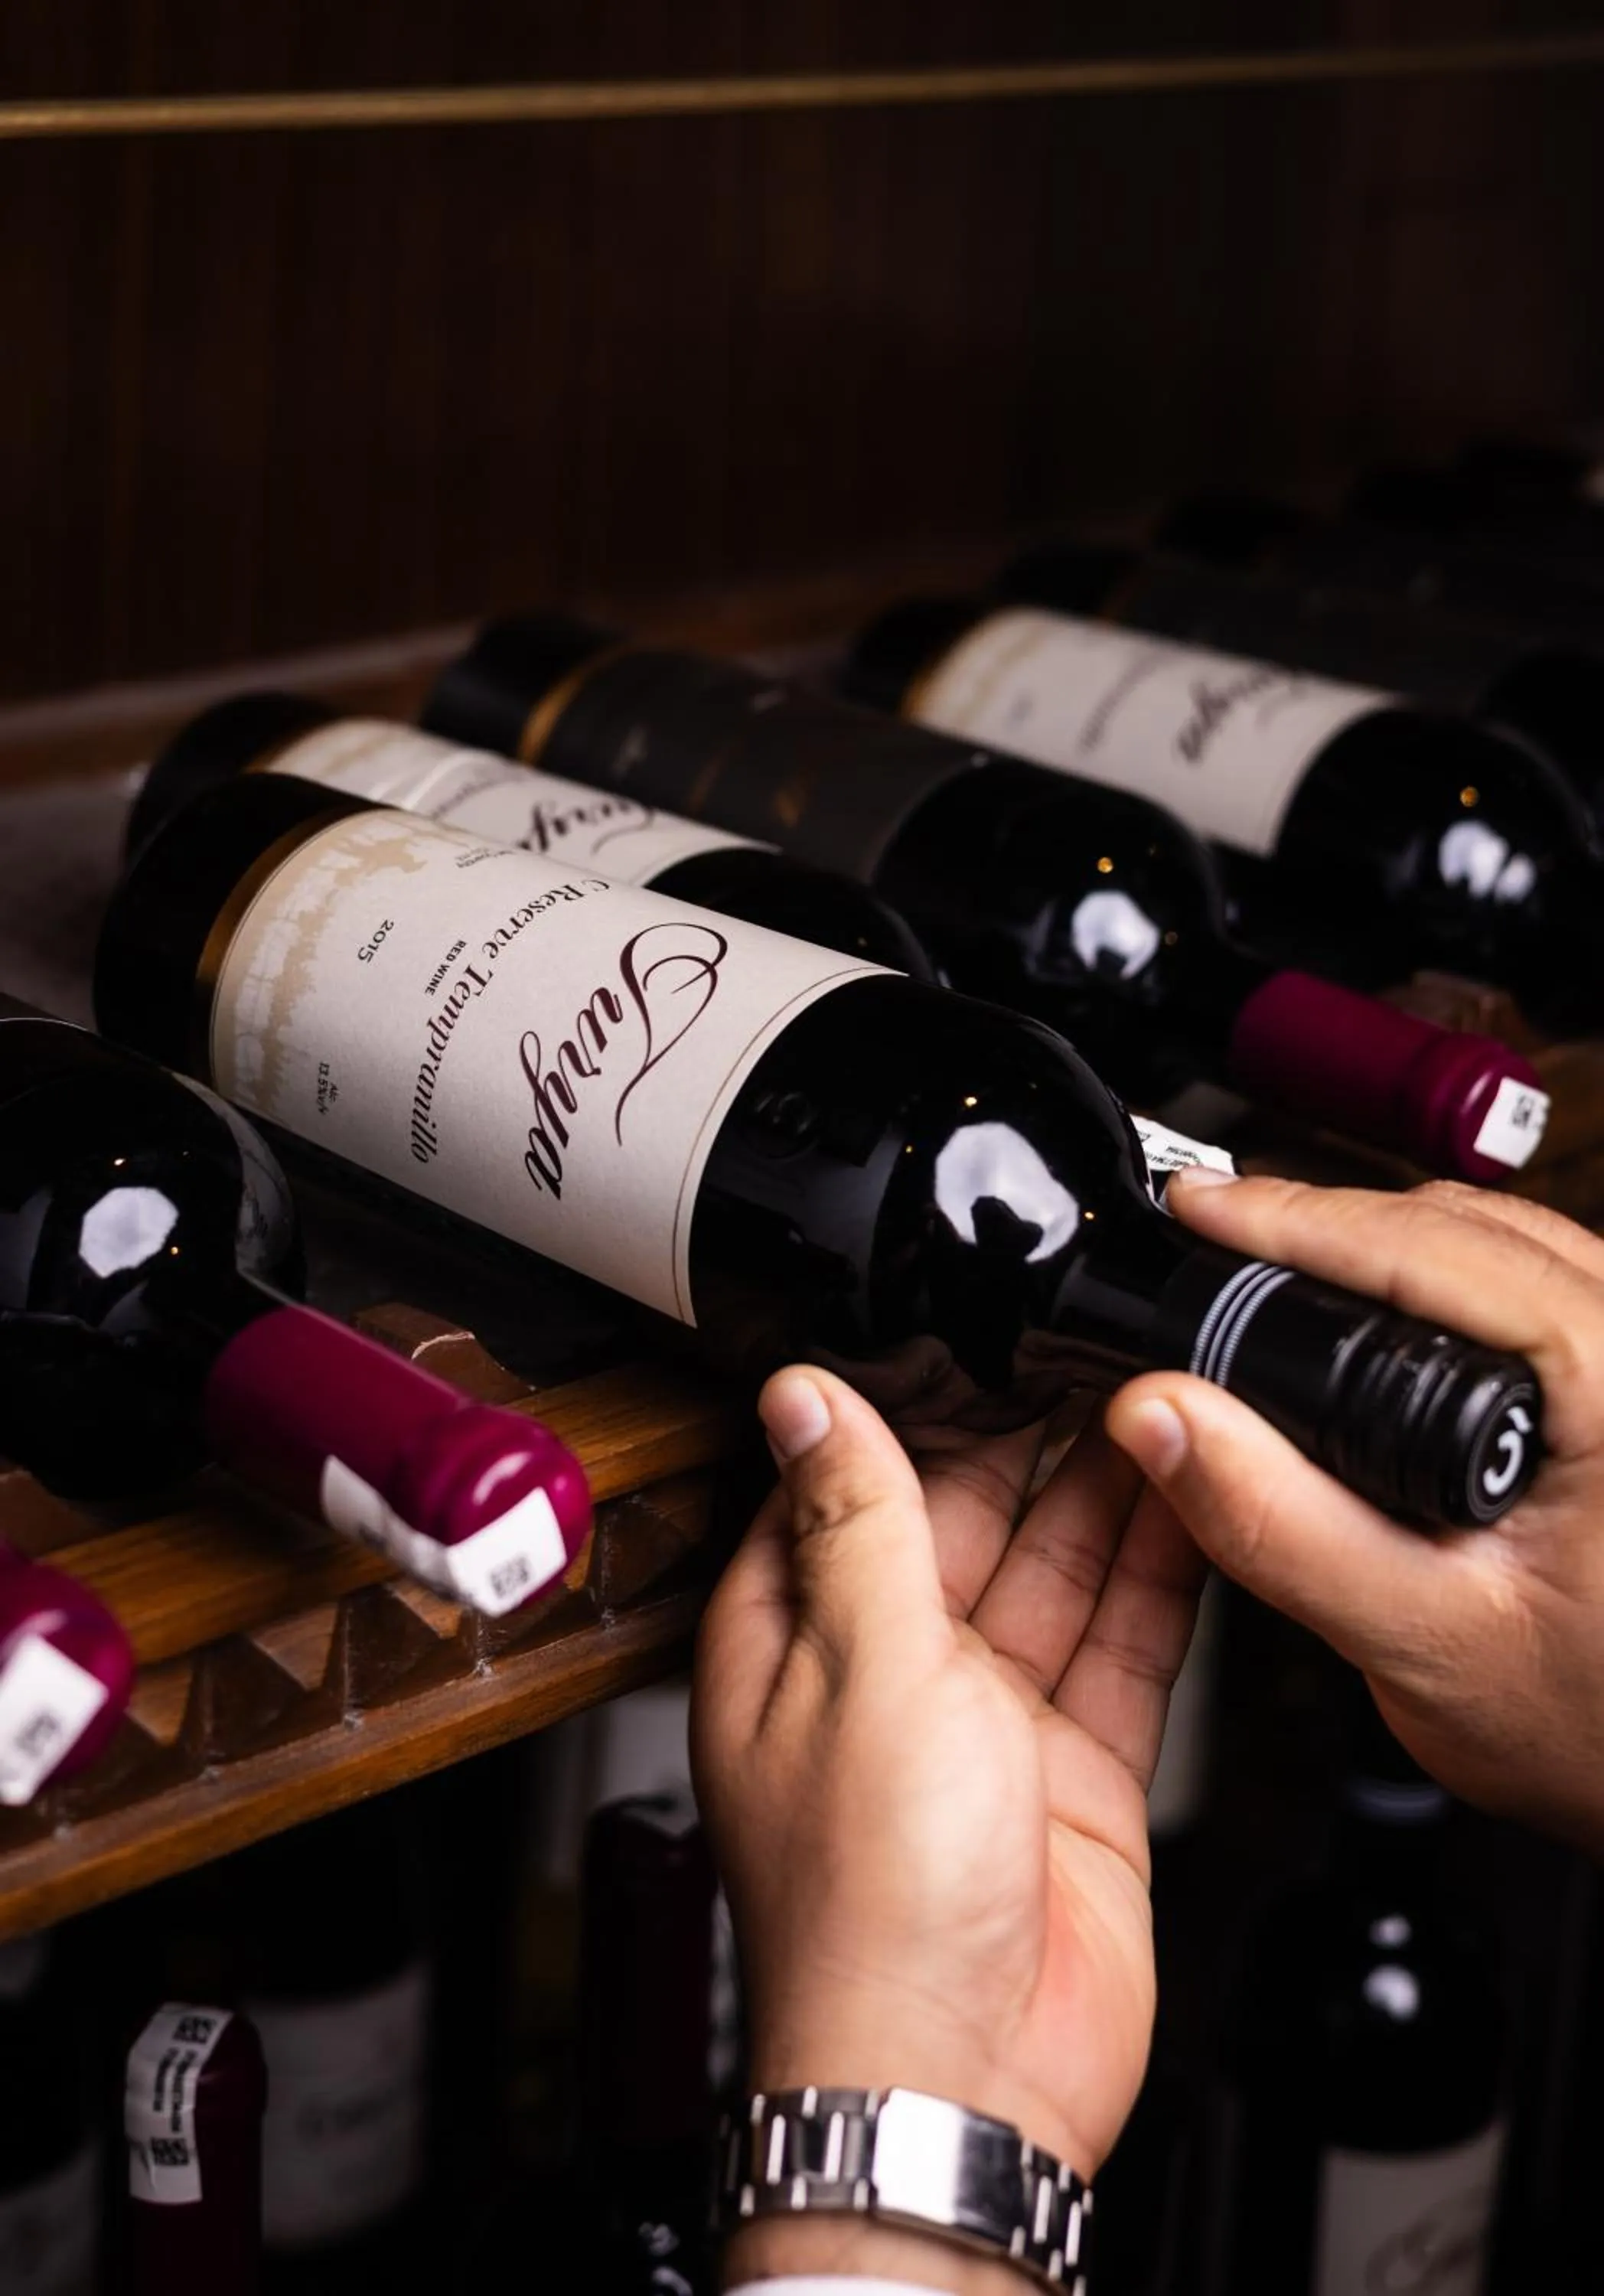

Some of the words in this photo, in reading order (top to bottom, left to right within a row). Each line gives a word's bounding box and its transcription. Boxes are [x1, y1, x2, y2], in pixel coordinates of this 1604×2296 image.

[357, 919, 394, 963] 2015
[445, 940, 467, 962] RED
[481, 884, 585, 959] Reserve
[425, 964, 450, 996] WINE
[411, 964, 494, 1163] Tempranillo
[519, 923, 728, 1200] Turya
